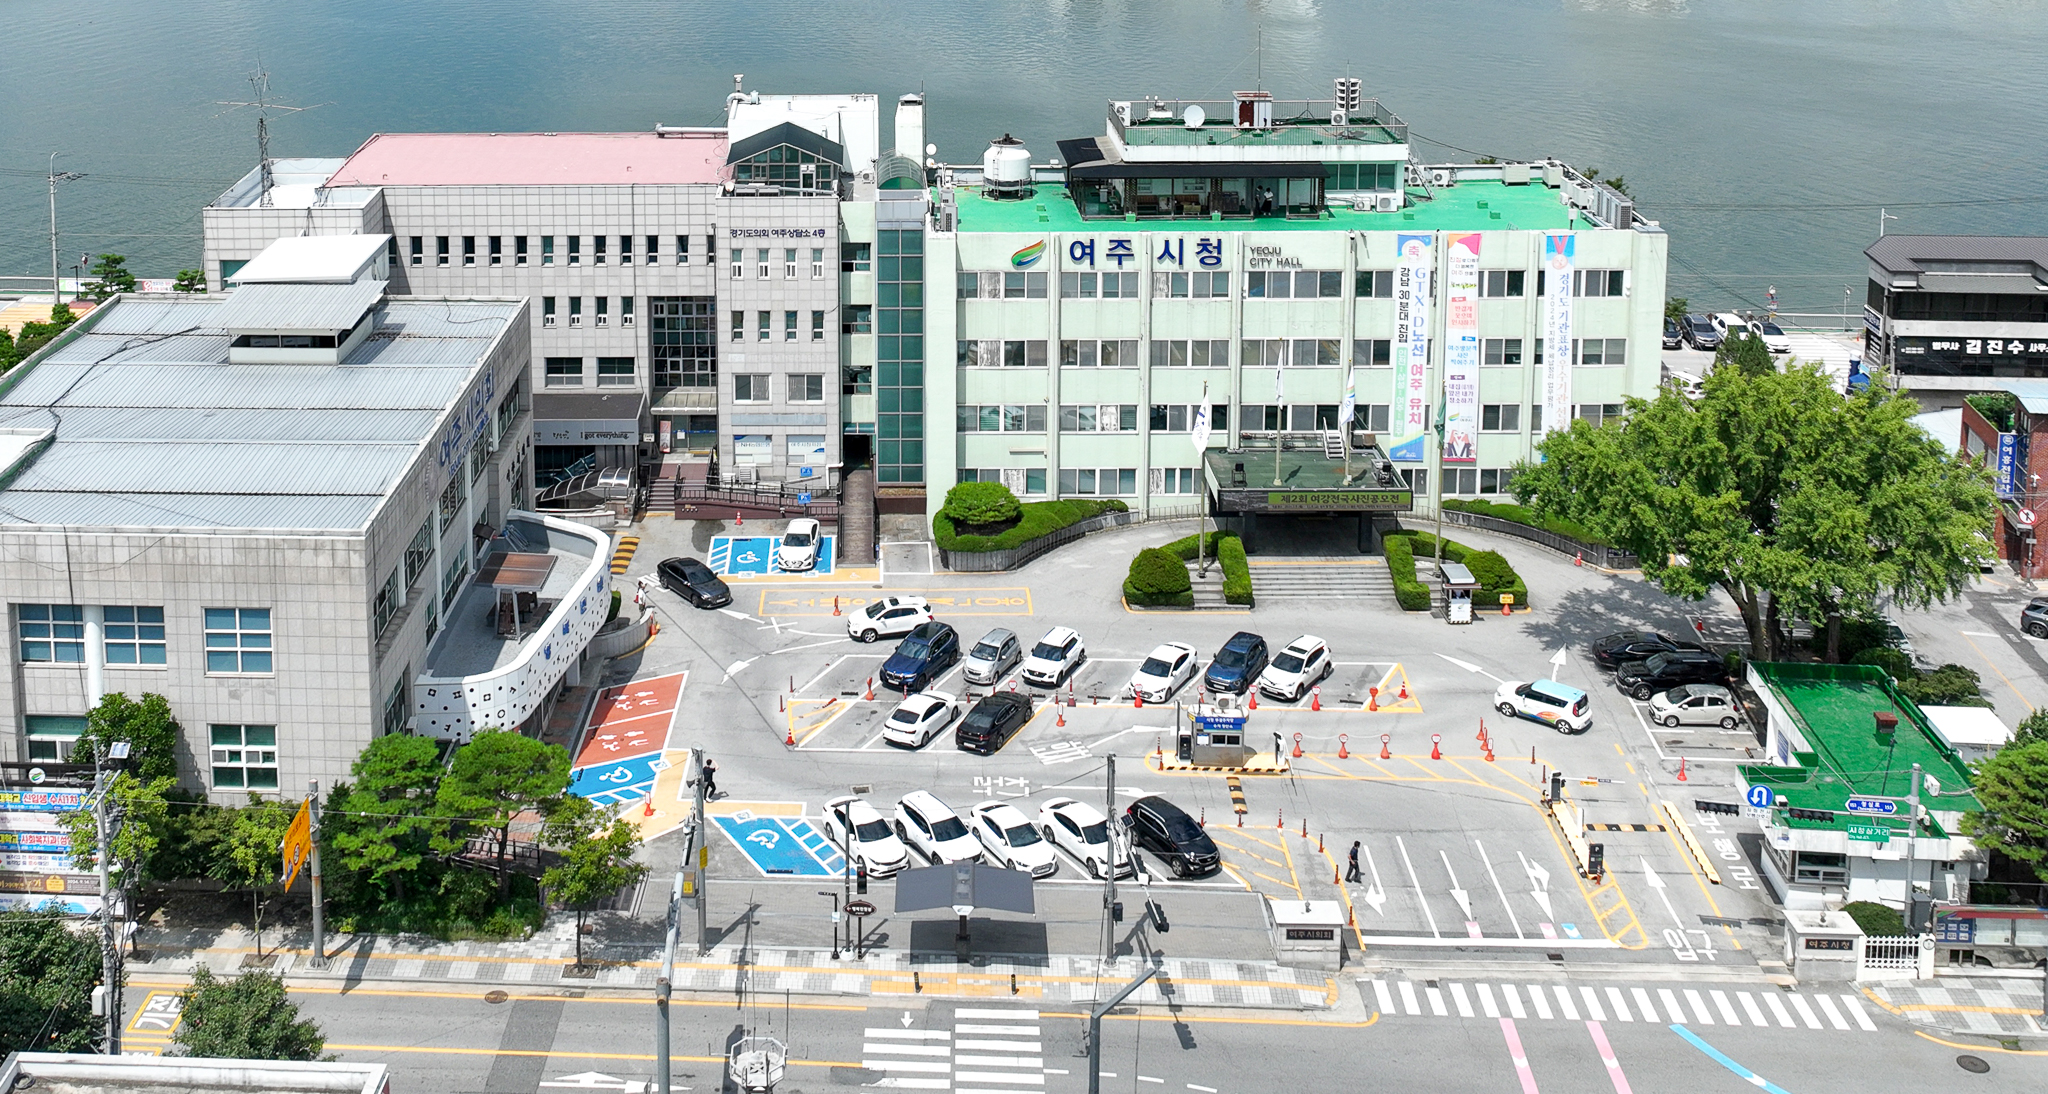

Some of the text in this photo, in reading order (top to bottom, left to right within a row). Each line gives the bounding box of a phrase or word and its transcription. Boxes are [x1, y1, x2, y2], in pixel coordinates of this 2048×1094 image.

[730, 229, 825, 238] 경기도의회 여주상담소 4층
[1069, 237, 1222, 267] 여주시청
[1249, 246, 1282, 257] YEOJU
[1249, 257, 1302, 268] CITY HALL
[1558, 273, 1569, 306] 경기도
[1398, 267, 1411, 343] 강남 30 분대 진입
[1557, 310, 1569, 357] 기관표창
[1932, 341, 1960, 351] 법무사
[1966, 339, 2024, 354] 김진수
[2028, 342, 2048, 353] 사무
[1408, 364, 1423, 425] 여주 유치
[440, 365, 495, 467] 여주시의회
[584, 432, 595, 441] got
[1280, 494, 1400, 504] 제2회 여강전국사진공모전
[23, 793, 48, 804] 신입생
[49, 794, 79, 805] 수시1차
[1849, 827, 1889, 835] 시청삼거리
[1289, 930, 1332, 939] 여주시의회
[1662, 928, 1719, 962] 입구
[1808, 940, 1850, 950] 여주시청
